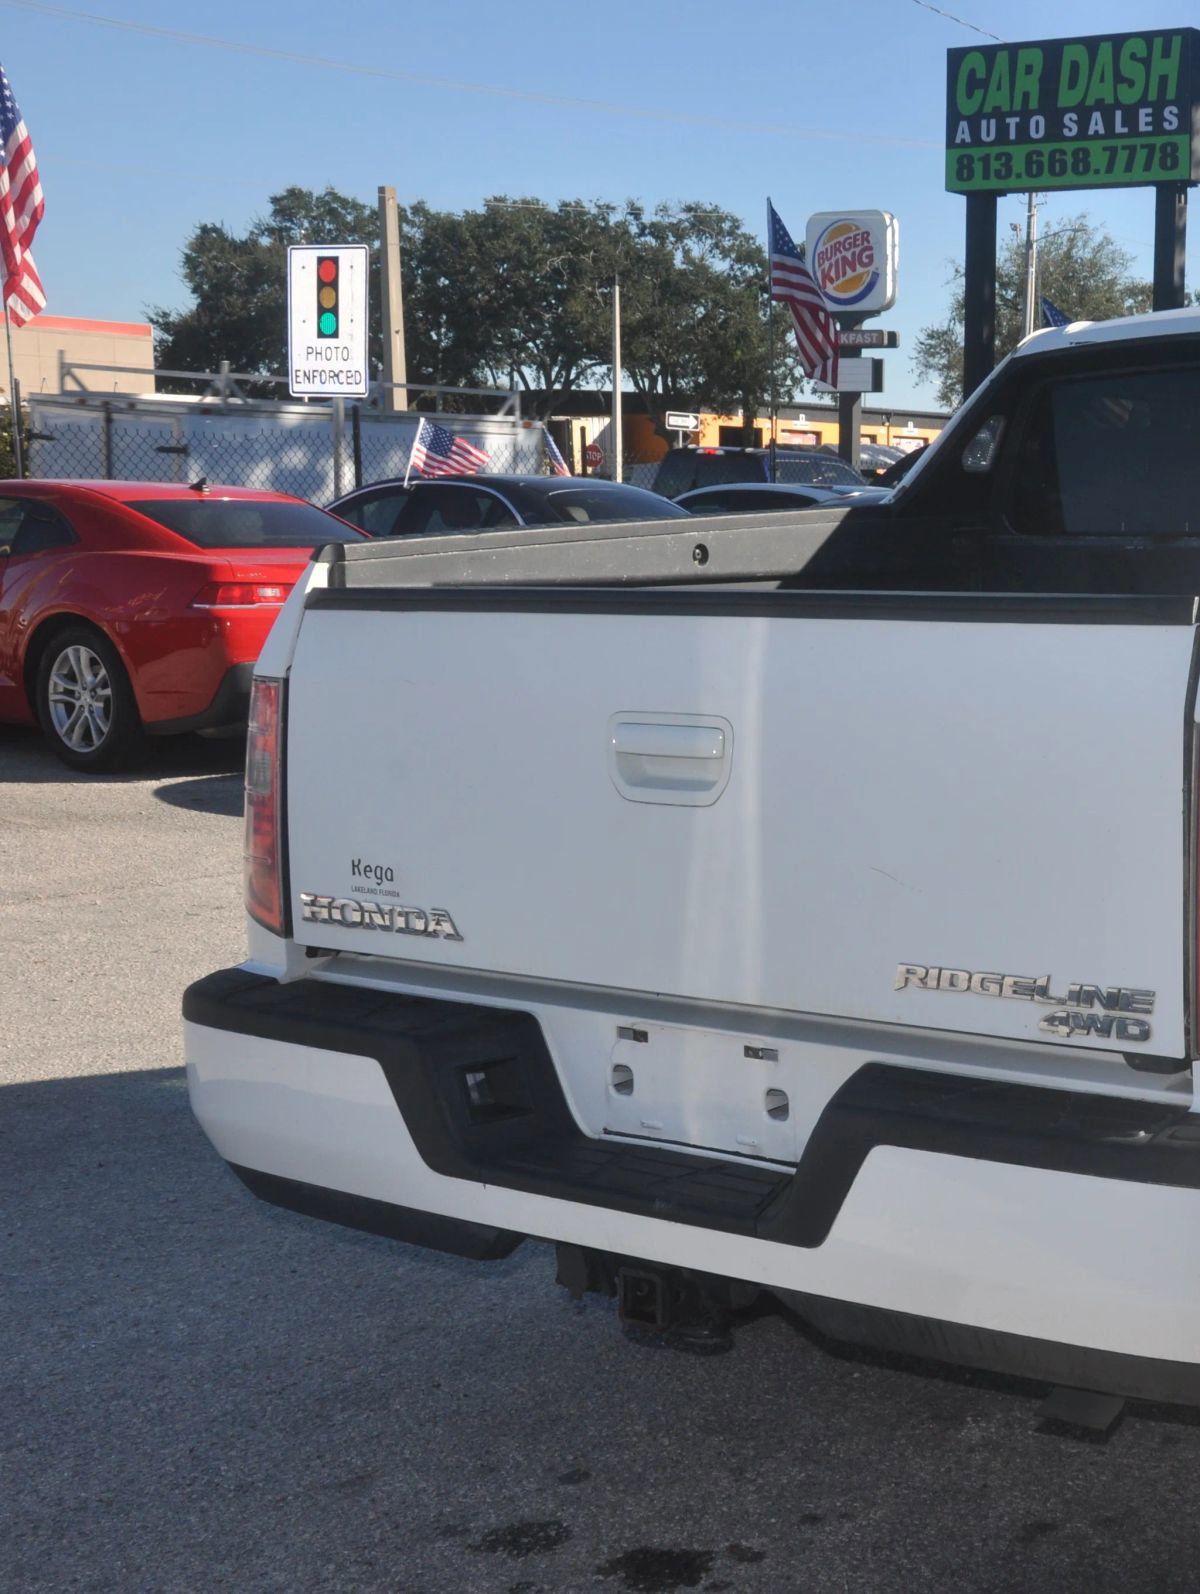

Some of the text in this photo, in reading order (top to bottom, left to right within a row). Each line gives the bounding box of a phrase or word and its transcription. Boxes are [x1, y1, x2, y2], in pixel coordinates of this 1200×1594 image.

[955, 35, 1183, 117] CAR DASH
[955, 105, 1180, 144] AUTO SALES
[955, 142, 1180, 182] 813.668.7778
[817, 230, 871, 269] BURGER
[820, 245, 874, 290] KING
[305, 346, 350, 362] PHOTO
[839, 332, 879, 345] KFAST
[294, 369, 362, 385] ENFORCED
[300, 892, 464, 942] HONDA
[894, 963, 1156, 1013] RIDGELINE
[1038, 1010, 1152, 1042] 4WD
